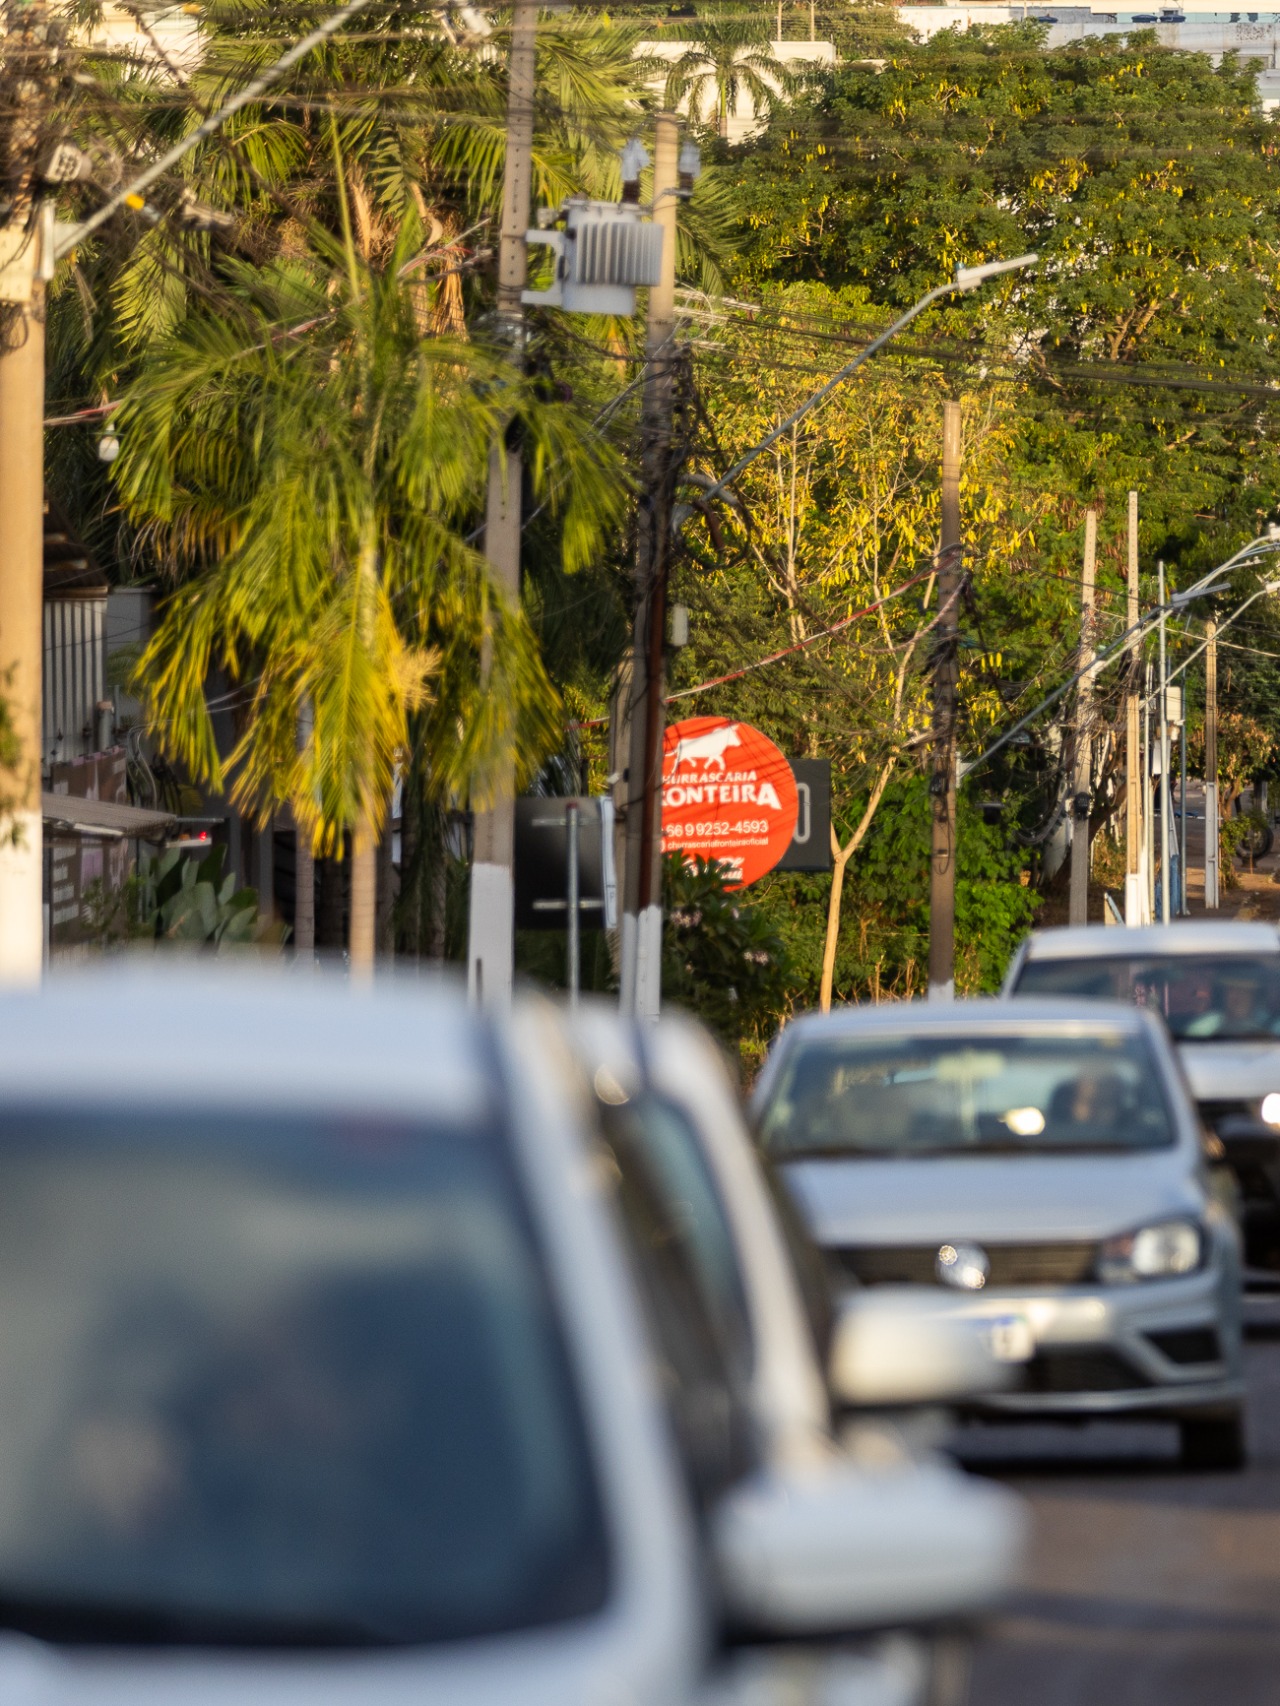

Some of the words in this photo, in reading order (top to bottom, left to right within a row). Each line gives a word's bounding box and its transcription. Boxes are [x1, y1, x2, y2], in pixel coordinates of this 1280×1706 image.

[662, 770, 757, 785] HURRASCARIA
[662, 783, 782, 810] ONTEIRA
[685, 823, 695, 837] 9
[696, 820, 768, 836] 9252-4593
